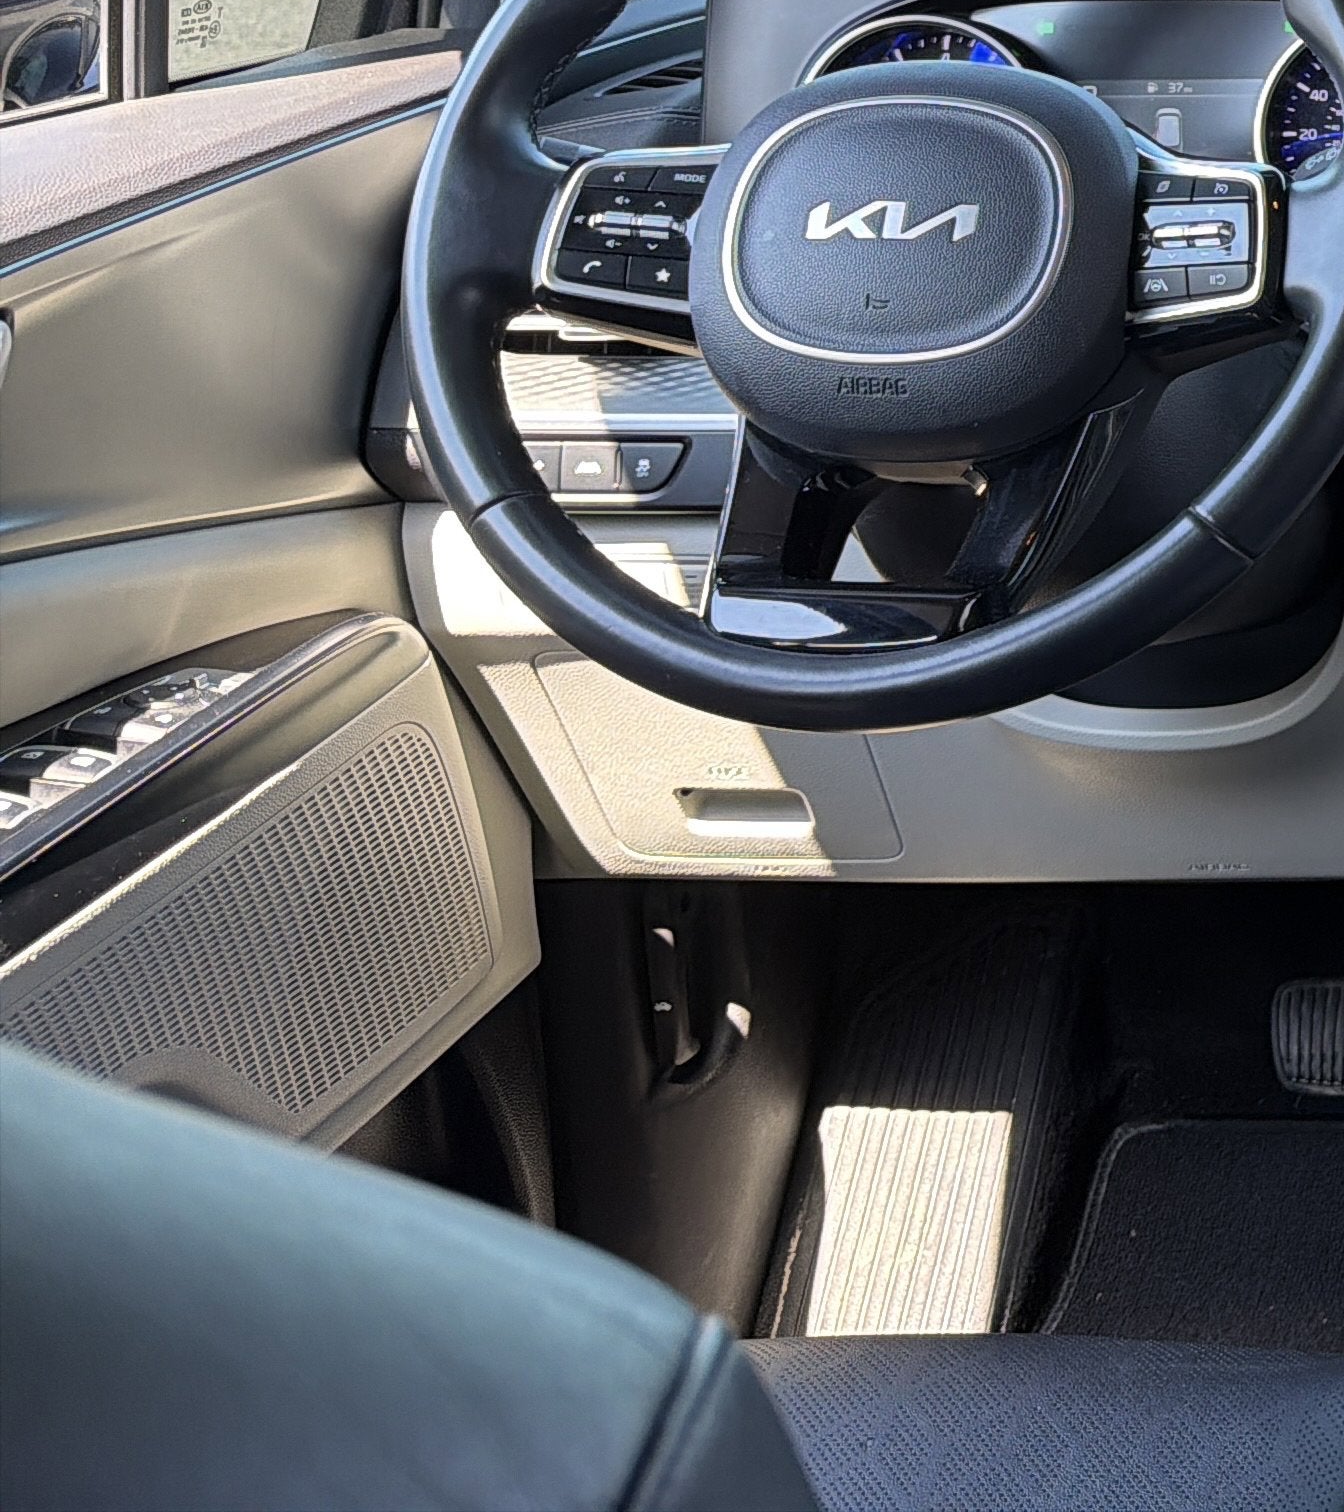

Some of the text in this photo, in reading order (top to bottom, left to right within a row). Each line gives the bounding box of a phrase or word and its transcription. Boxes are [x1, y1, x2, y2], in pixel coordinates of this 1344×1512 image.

[1309, 89, 1328, 102] 40
[1299, 128, 1318, 141] 20
[673, 171, 706, 184] MODE
[835, 375, 909, 397] AIRBAG
